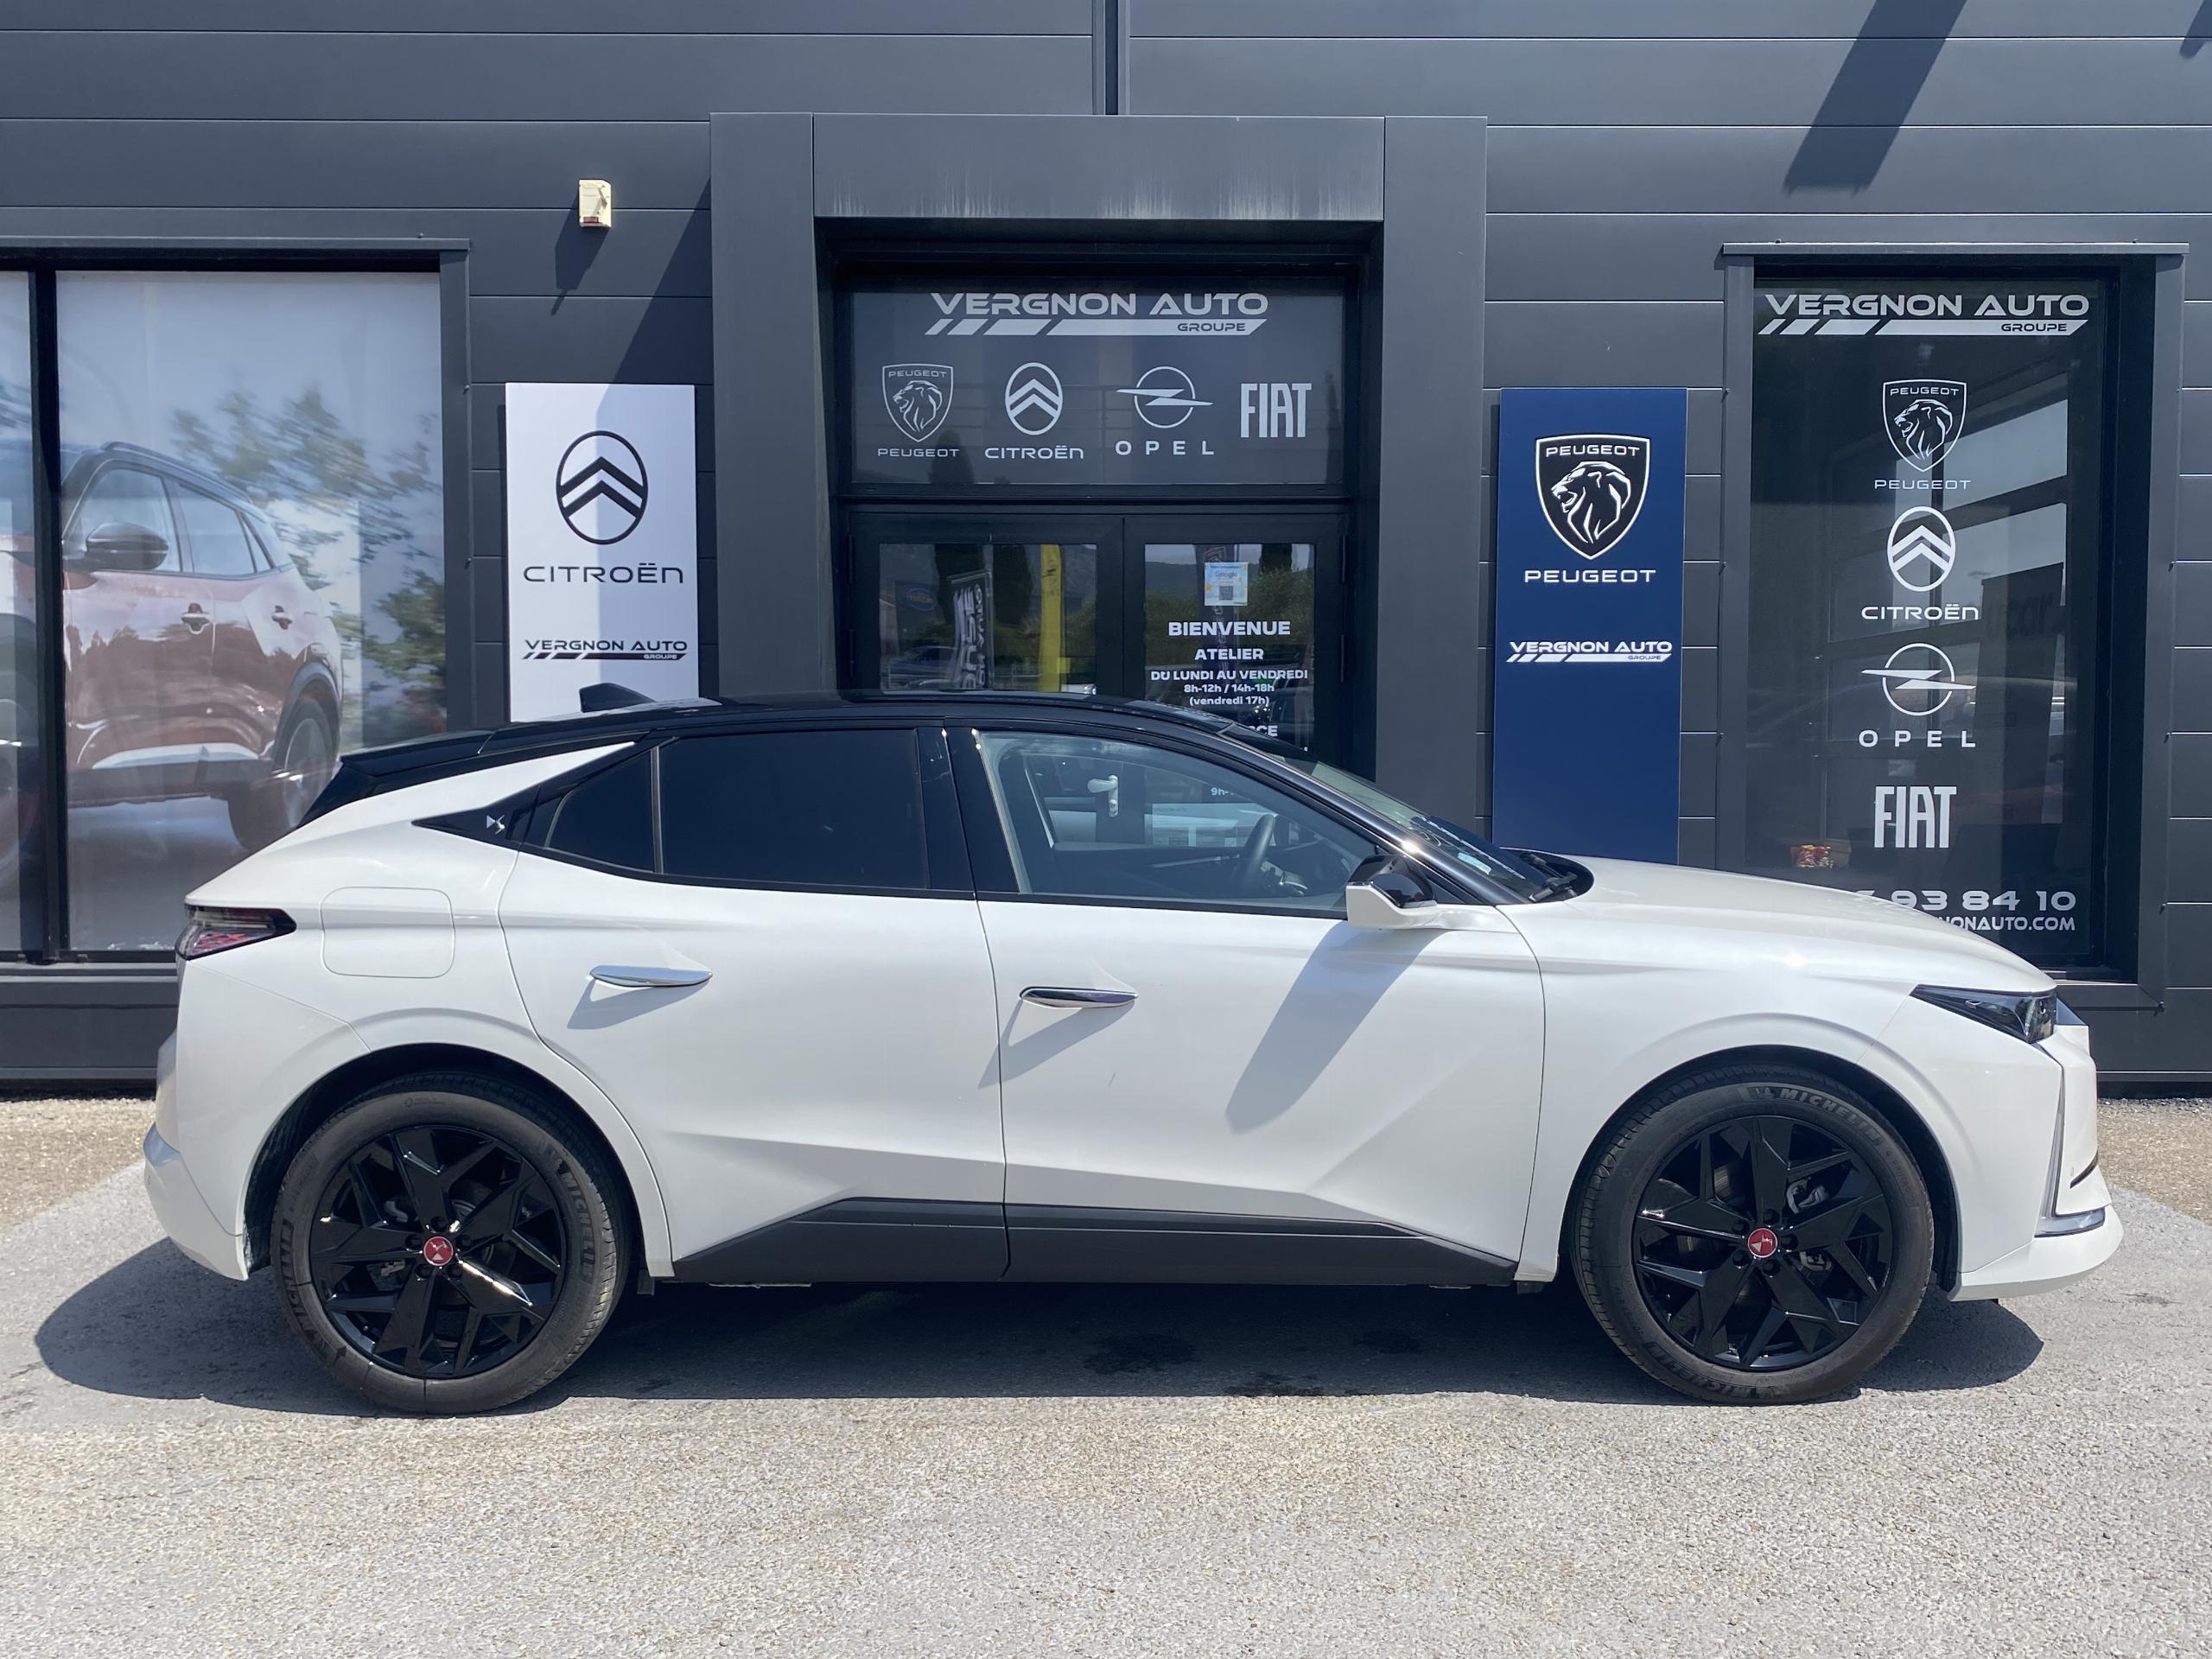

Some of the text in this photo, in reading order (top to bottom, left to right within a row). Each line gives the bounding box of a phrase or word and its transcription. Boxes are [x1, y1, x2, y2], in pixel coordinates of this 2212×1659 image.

[931, 293, 1268, 315] VERGNON AUTO
[1765, 294, 2090, 316] VERGNON AUTO
[1178, 323, 1245, 332] GROUPE
[2001, 323, 2067, 333] GROUPE
[888, 369, 947, 378] PEUGEOT
[1890, 387, 1960, 396] PEUGEOT
[1240, 383, 1312, 438] FIAT
[878, 448, 959, 457] PEUGEOT
[1116, 441, 1214, 455] OPEL
[1546, 444, 1640, 457] PEUGEOT
[1874, 480, 1971, 490] PEUGEOT
[1524, 569, 1656, 582] PEUGEOT
[1168, 621, 1291, 636] BIENVENUE
[524, 639, 688, 651] VERGNON AUTO
[1510, 641, 1672, 652] VERGNON AUTO
[1194, 648, 1264, 660] ATELIER
[1150, 670, 1308, 680] DU LUNDI AU VENDREDI
[1184, 683, 1222, 693] 8h-12h
[1231, 683, 1274, 692] 14h-18h
[1189, 696, 1270, 706] (vendredi 17h)
[1859, 730, 1976, 747] OPEL
[1874, 785, 1957, 849] FIAT
[1961, 890, 2021, 911] 84
[2036, 890, 2076, 911] 10
[1780, 1087, 1885, 1144] MICHELIN
[561, 1172, 594, 1276] MICHELIN
